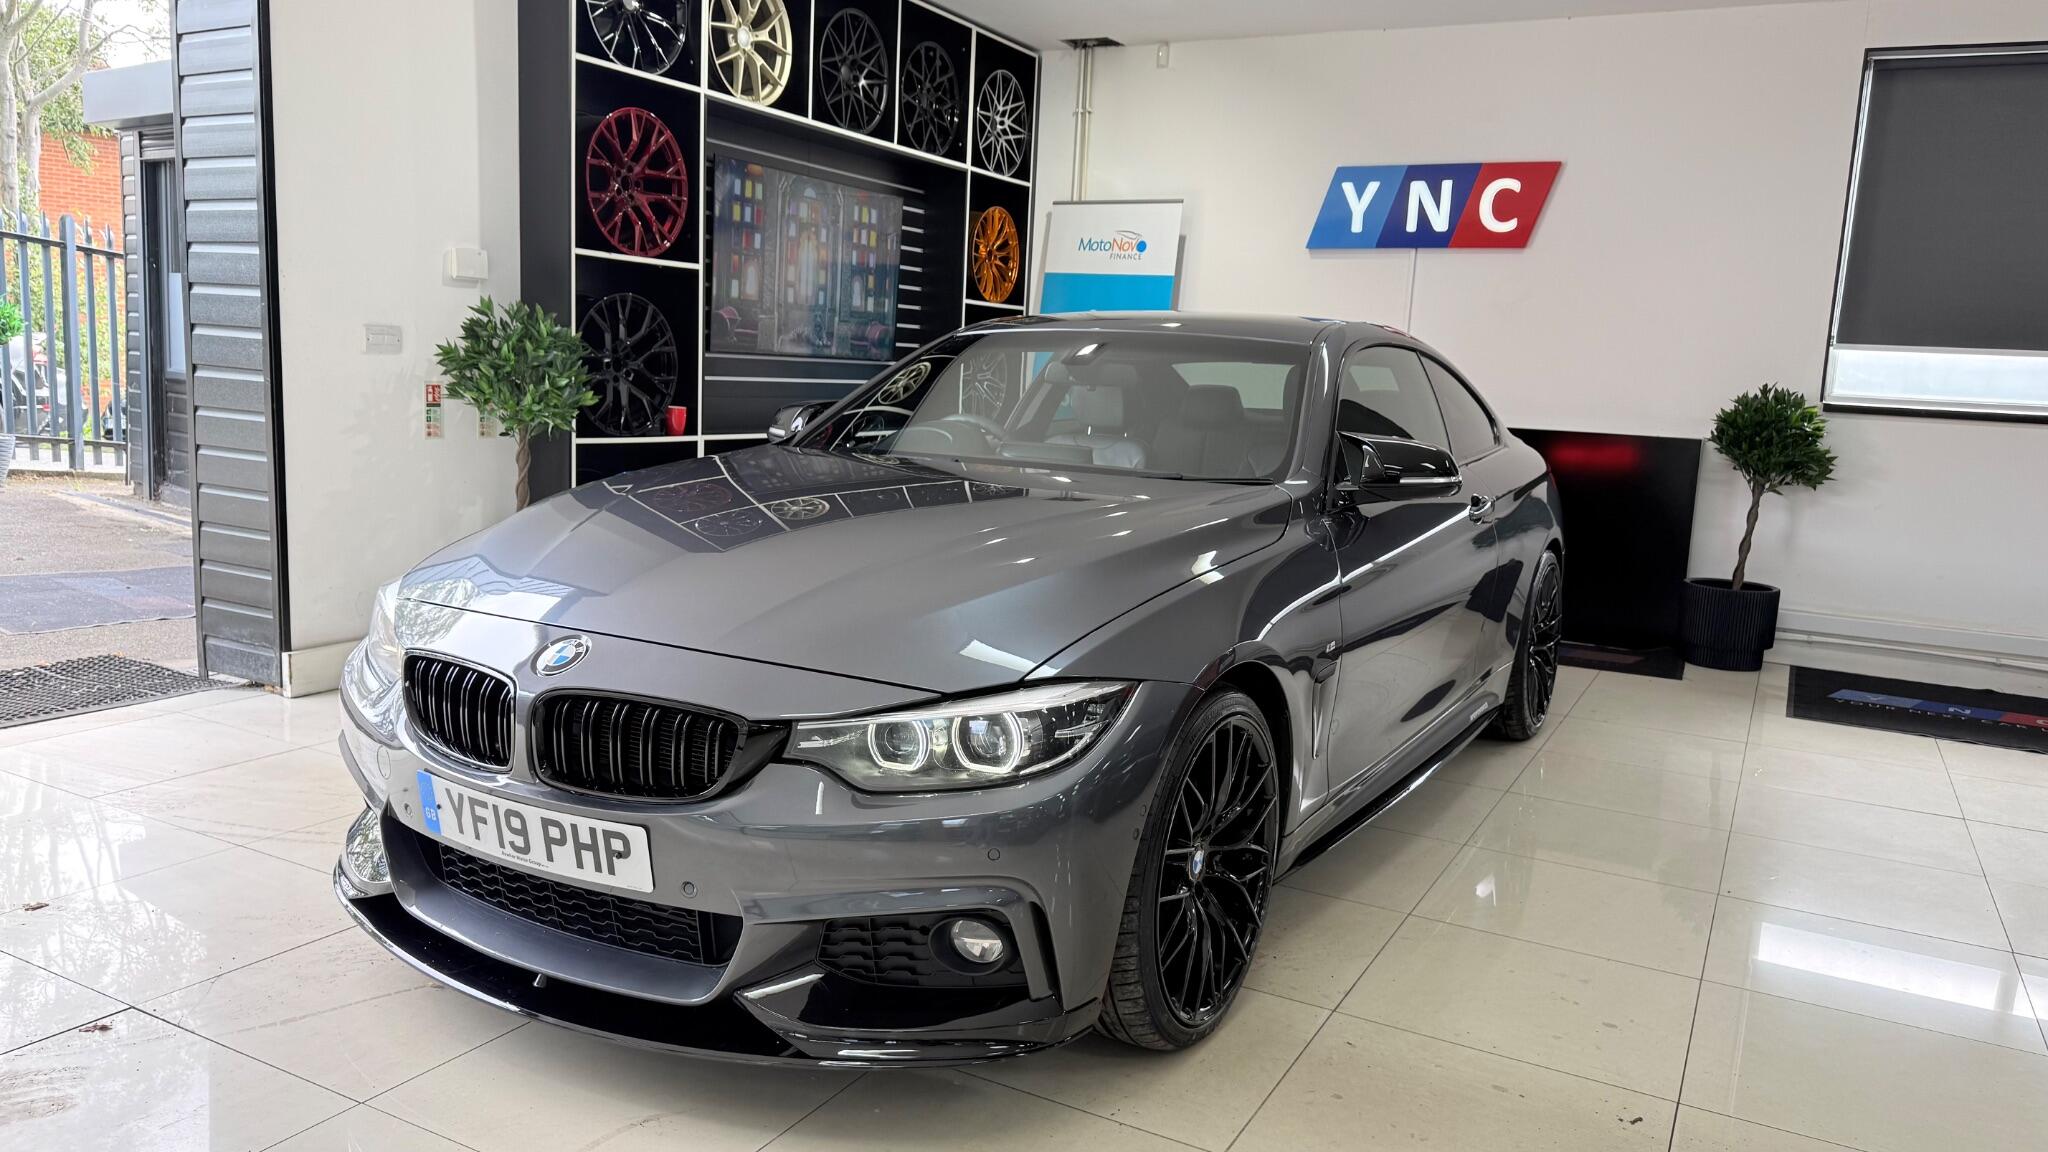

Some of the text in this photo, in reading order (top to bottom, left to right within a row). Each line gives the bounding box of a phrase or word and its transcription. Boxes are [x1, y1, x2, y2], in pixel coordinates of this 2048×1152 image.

[1341, 177, 1522, 233] YNC
[1109, 252, 1143, 261] FINANCE
[424, 806, 437, 820] GB
[444, 787, 632, 877] YF19 PHP
